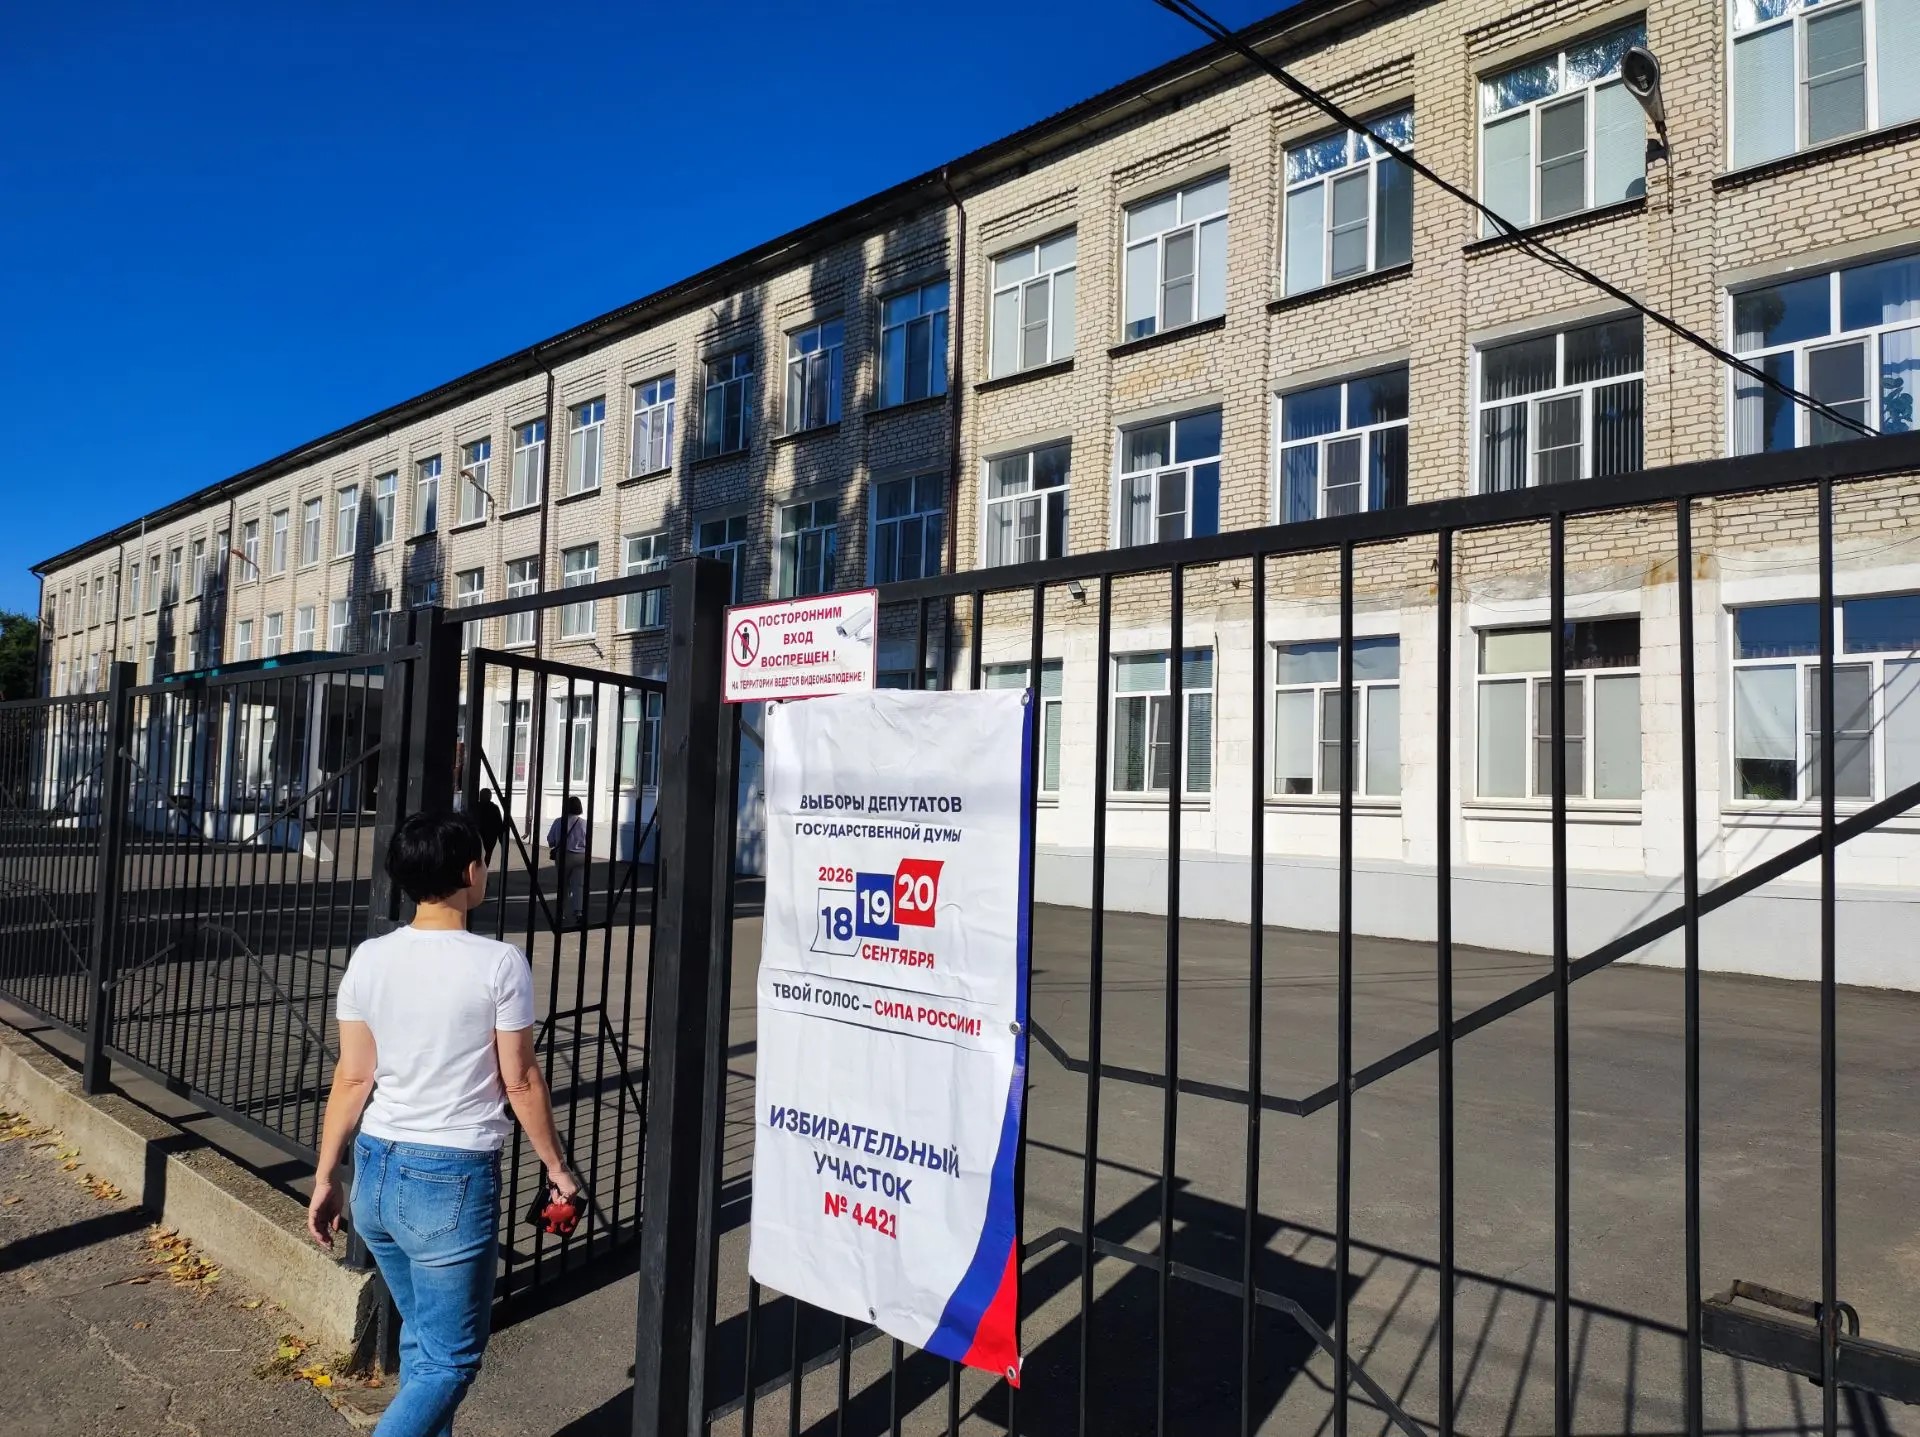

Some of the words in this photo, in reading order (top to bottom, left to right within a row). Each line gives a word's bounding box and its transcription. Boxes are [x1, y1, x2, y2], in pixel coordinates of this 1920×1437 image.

[758, 606, 842, 628] ПОСТОРОННИМ
[783, 631, 814, 645] ВХОД
[761, 650, 830, 668] ВОСПРЕЩЕН
[731, 680, 739, 690] НА
[739, 677, 774, 690] ТЕРРИТОРИИ
[774, 675, 800, 688] ВЕДЕТСЯ
[800, 672, 862, 686] ВИДЕОНАБЛЮДЕНИЕ
[800, 794, 865, 811] ВЫБОРЫ
[867, 795, 962, 814] ДЕПУТАТОВ
[796, 823, 920, 840] ГОСУДАРСТВЕННОЙ
[923, 828, 962, 843] ДУМЫ
[818, 866, 854, 883] 2026
[821, 906, 853, 941] 18
[860, 889, 891, 926] 19
[898, 873, 935, 912] 20
[862, 943, 935, 969] СЕНТЯБРЯ
[772, 982, 811, 1002] ТВОЙ
[815, 988, 860, 1011] ГОЛОС
[874, 999, 914, 1021] СИЛА
[917, 1007, 982, 1036] РОССИИ!
[769, 1105, 960, 1178] ИЗБИРАТЕЛЬНЫЙ
[813, 1151, 913, 1204] УЧАСТОК
[824, 1191, 848, 1218] №
[852, 1203, 897, 1240] 4421
